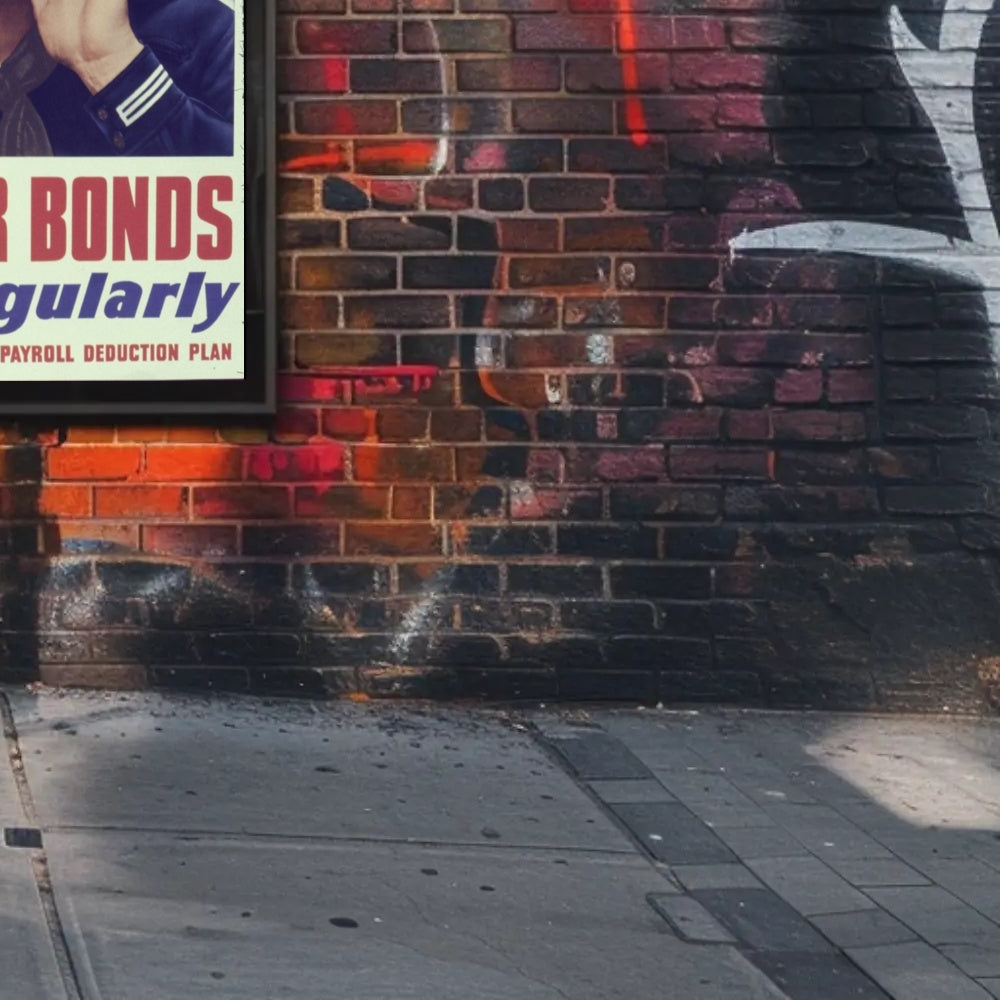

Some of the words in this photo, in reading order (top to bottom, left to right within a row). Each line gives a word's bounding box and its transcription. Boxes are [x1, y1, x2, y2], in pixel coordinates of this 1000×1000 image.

[30, 175, 234, 262] BONDS
[0, 344, 74, 363] PAYROLL
[83, 343, 180, 362] DEDUCTION
[189, 343, 232, 360] PLAN
